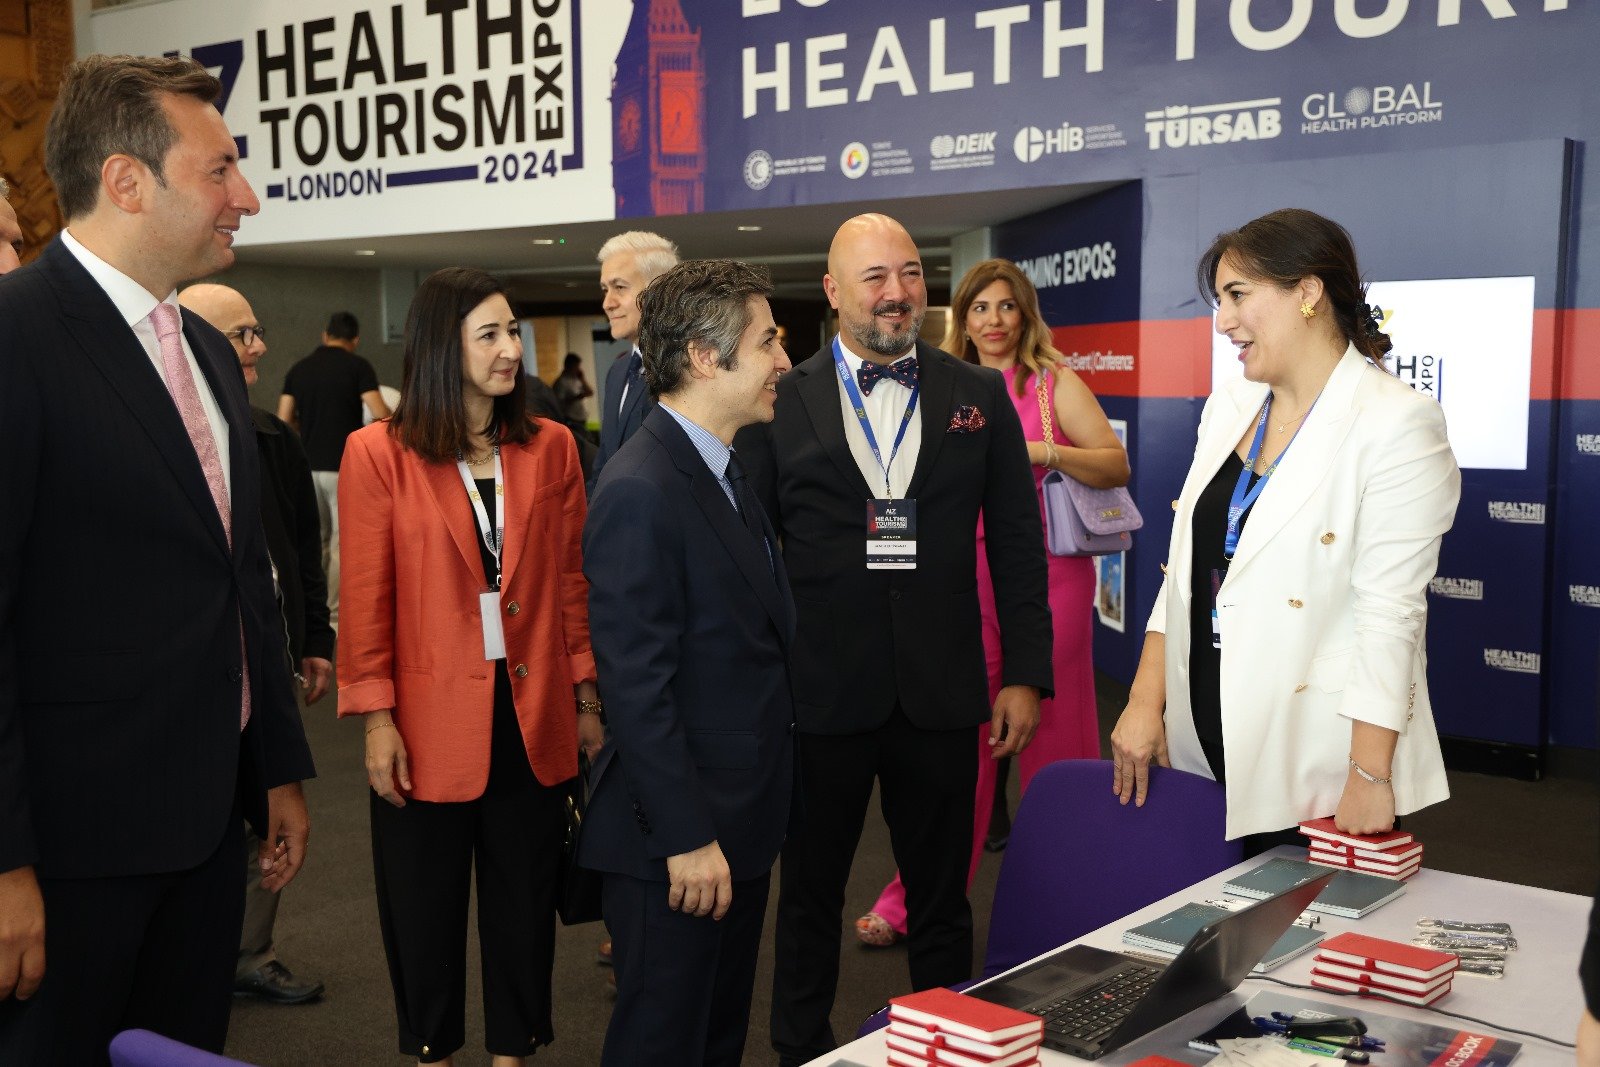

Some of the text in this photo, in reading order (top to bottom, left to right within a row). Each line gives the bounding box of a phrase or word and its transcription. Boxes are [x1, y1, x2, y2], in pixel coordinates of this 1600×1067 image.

[256, 0, 525, 101] HEALTH
[742, 0, 1104, 119] HEALTH
[260, 73, 526, 169] TOURISM
[1301, 109, 1443, 135] HEALTH PLATFORM
[287, 168, 384, 201] LONDON
[484, 149, 558, 184] 2024
[1421, 355, 1434, 397] XPO
[1454, 1035, 1484, 1060] BOOK
